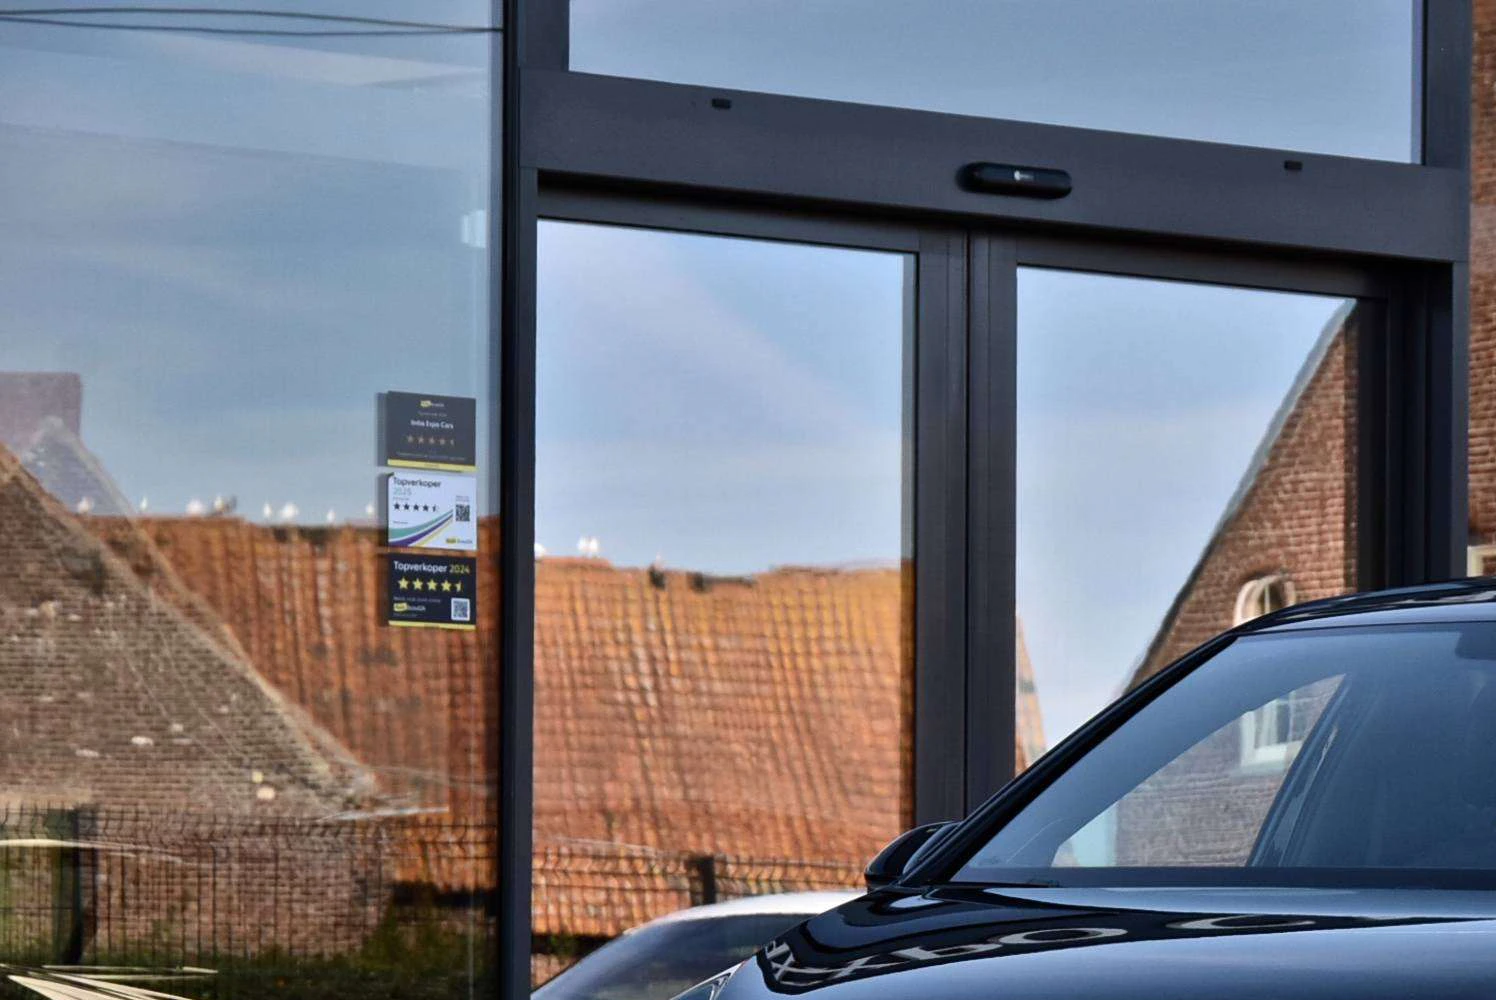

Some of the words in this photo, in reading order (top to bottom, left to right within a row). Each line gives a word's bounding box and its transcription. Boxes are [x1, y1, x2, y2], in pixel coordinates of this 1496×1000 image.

[393, 477, 441, 489] Topverkoper
[393, 560, 448, 574] Topverkoper
[449, 564, 471, 575] 2024
